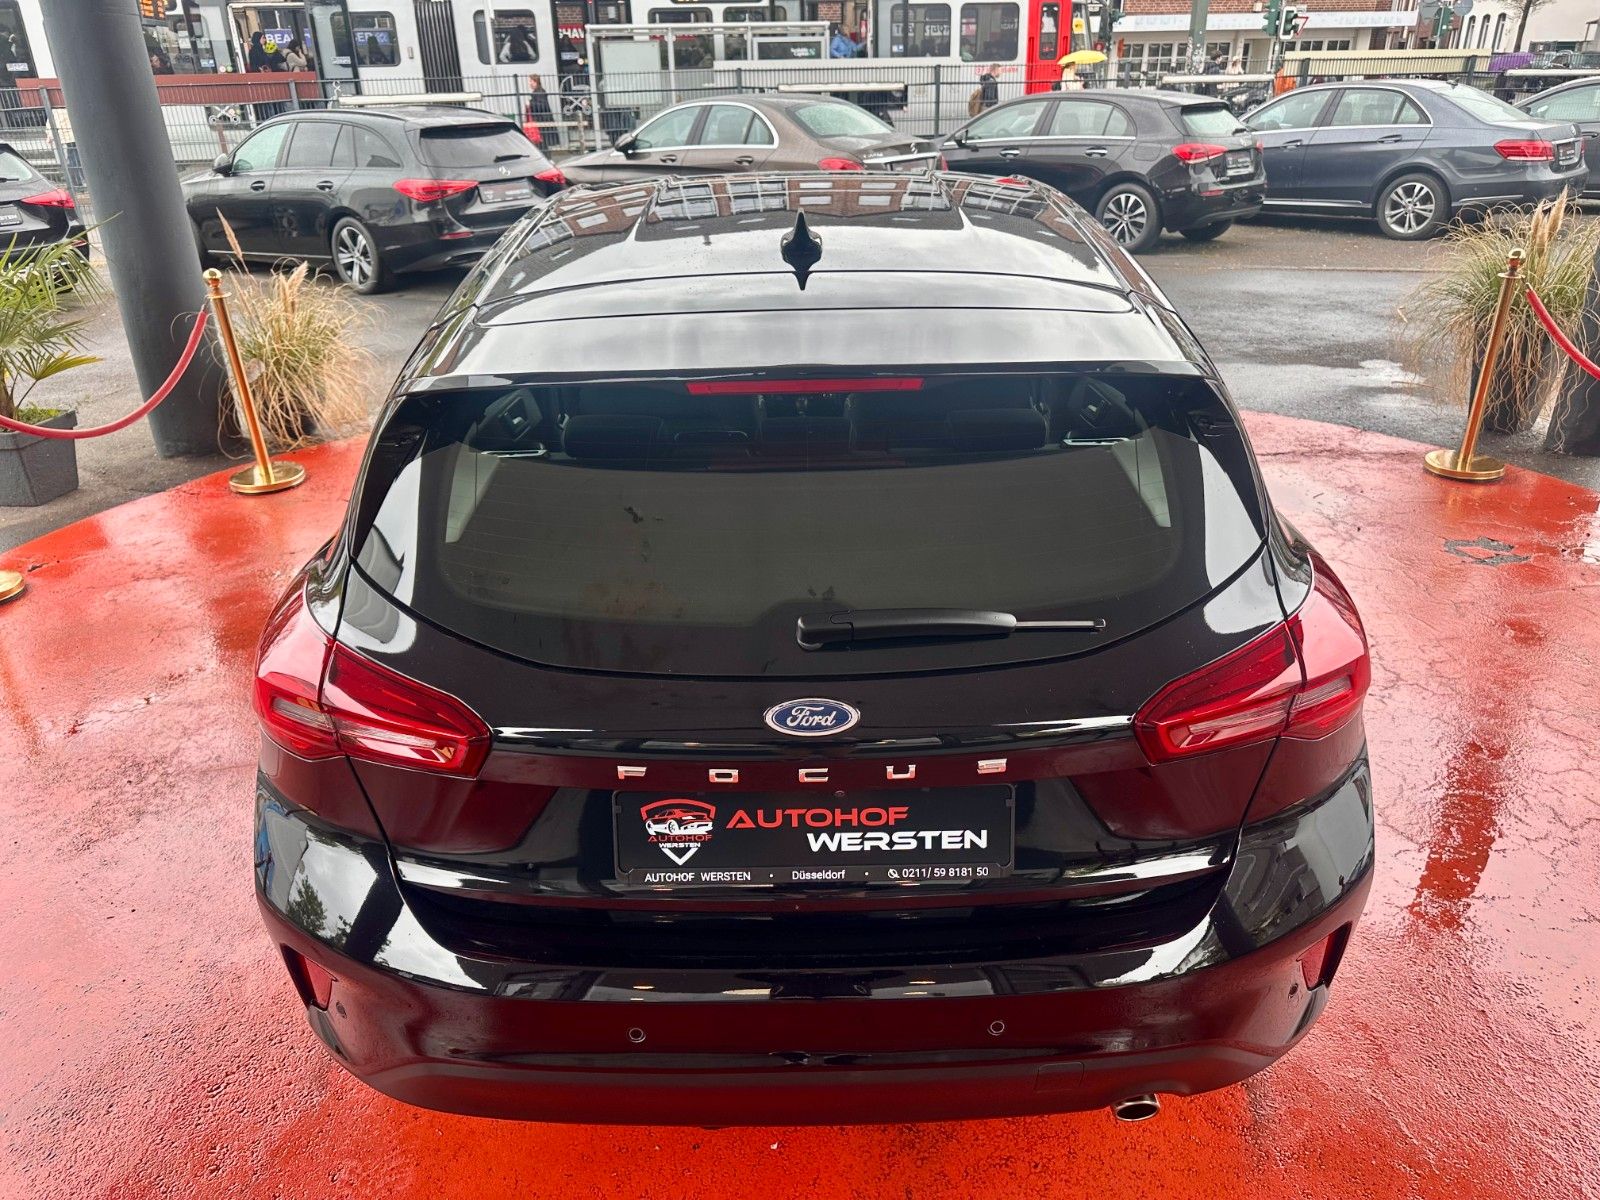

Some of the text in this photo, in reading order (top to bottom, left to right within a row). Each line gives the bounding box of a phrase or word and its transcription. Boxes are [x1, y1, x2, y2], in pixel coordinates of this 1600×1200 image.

[786, 706, 837, 727] Ford
[617, 758, 1008, 784] FOCUS
[726, 806, 910, 829] AUTOHOF
[647, 833, 713, 842] AUTOHOF
[806, 829, 988, 852] WERSTEN
[644, 866, 990, 882] AUTOHOF WERSTEN Düsseldorf 0211/ 59 8181 50
